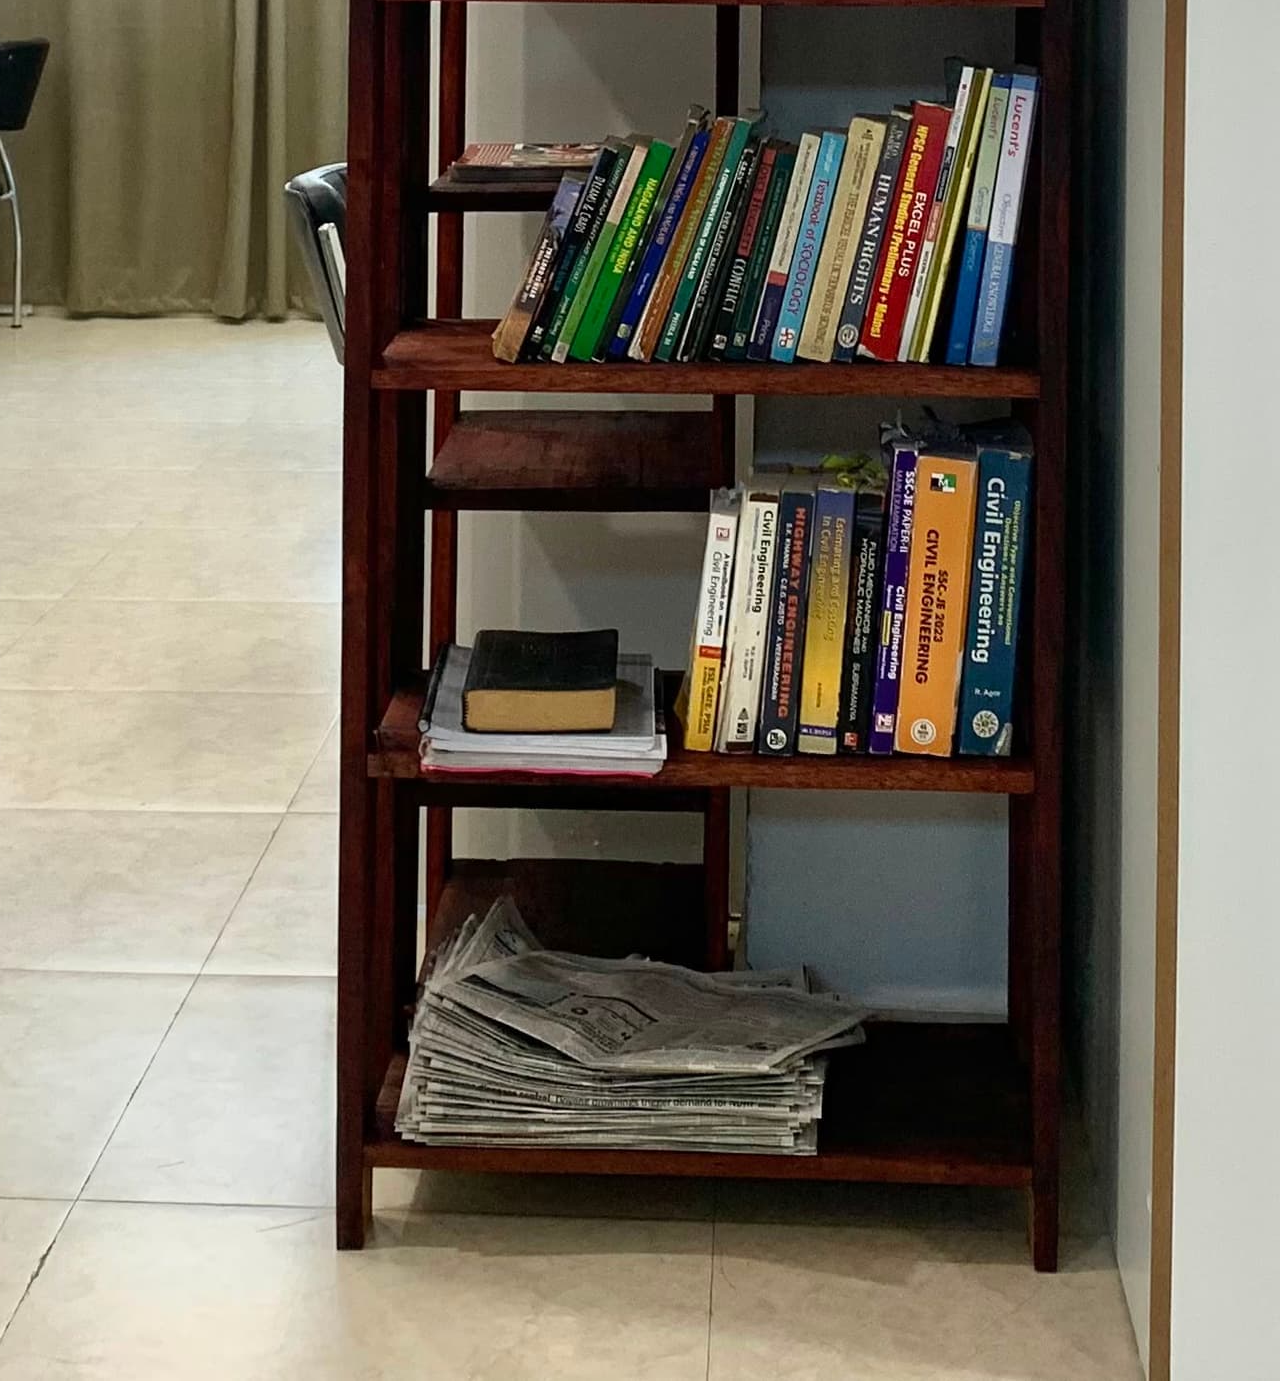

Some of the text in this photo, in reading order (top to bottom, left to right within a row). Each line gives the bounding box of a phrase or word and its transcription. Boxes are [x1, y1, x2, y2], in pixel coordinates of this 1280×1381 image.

[1006, 94, 1027, 157] Lucent's
[630, 176, 658, 228] NAGALAND
[807, 177, 829, 226] Textbook
[902, 152, 922, 192] General
[622, 226, 638, 249] AND
[804, 228, 817, 241] of
[848, 173, 891, 306] HUMAN RIGHTS
[893, 192, 913, 231] Studies
[897, 191, 927, 278] EXCEL PLUS
[611, 247, 630, 275] INDIA
[721, 256, 746, 313] CONFLICT
[785, 241, 814, 316] SOCIOLOGY
[761, 510, 774, 537] Civil
[819, 528, 830, 551] Civil
[889, 469, 903, 552] MAIN EXAMINATION
[899, 470, 914, 553] SSC-JE PAPER-II
[750, 538, 770, 613] Engineering
[830, 517, 845, 575] Estimating
[867, 540, 877, 570] FLUID
[970, 476, 1004, 663] Civil Engineering
[702, 550, 722, 636] Civil Engineering
[718, 600, 724, 610] on
[776, 507, 806, 718] HIGHWAY ENGINEERING
[830, 577, 841, 597] and
[852, 537, 868, 654] HYDRAULIC MACHINES
[862, 572, 874, 634] MECHANICS
[894, 585, 905, 611] Civil
[914, 528, 939, 684] CIVIL ENGINEERING
[933, 568, 948, 642] SSC-JE 2023
[886, 612, 902, 679] Engineering
[847, 661, 860, 721] SUBRAMANYA
